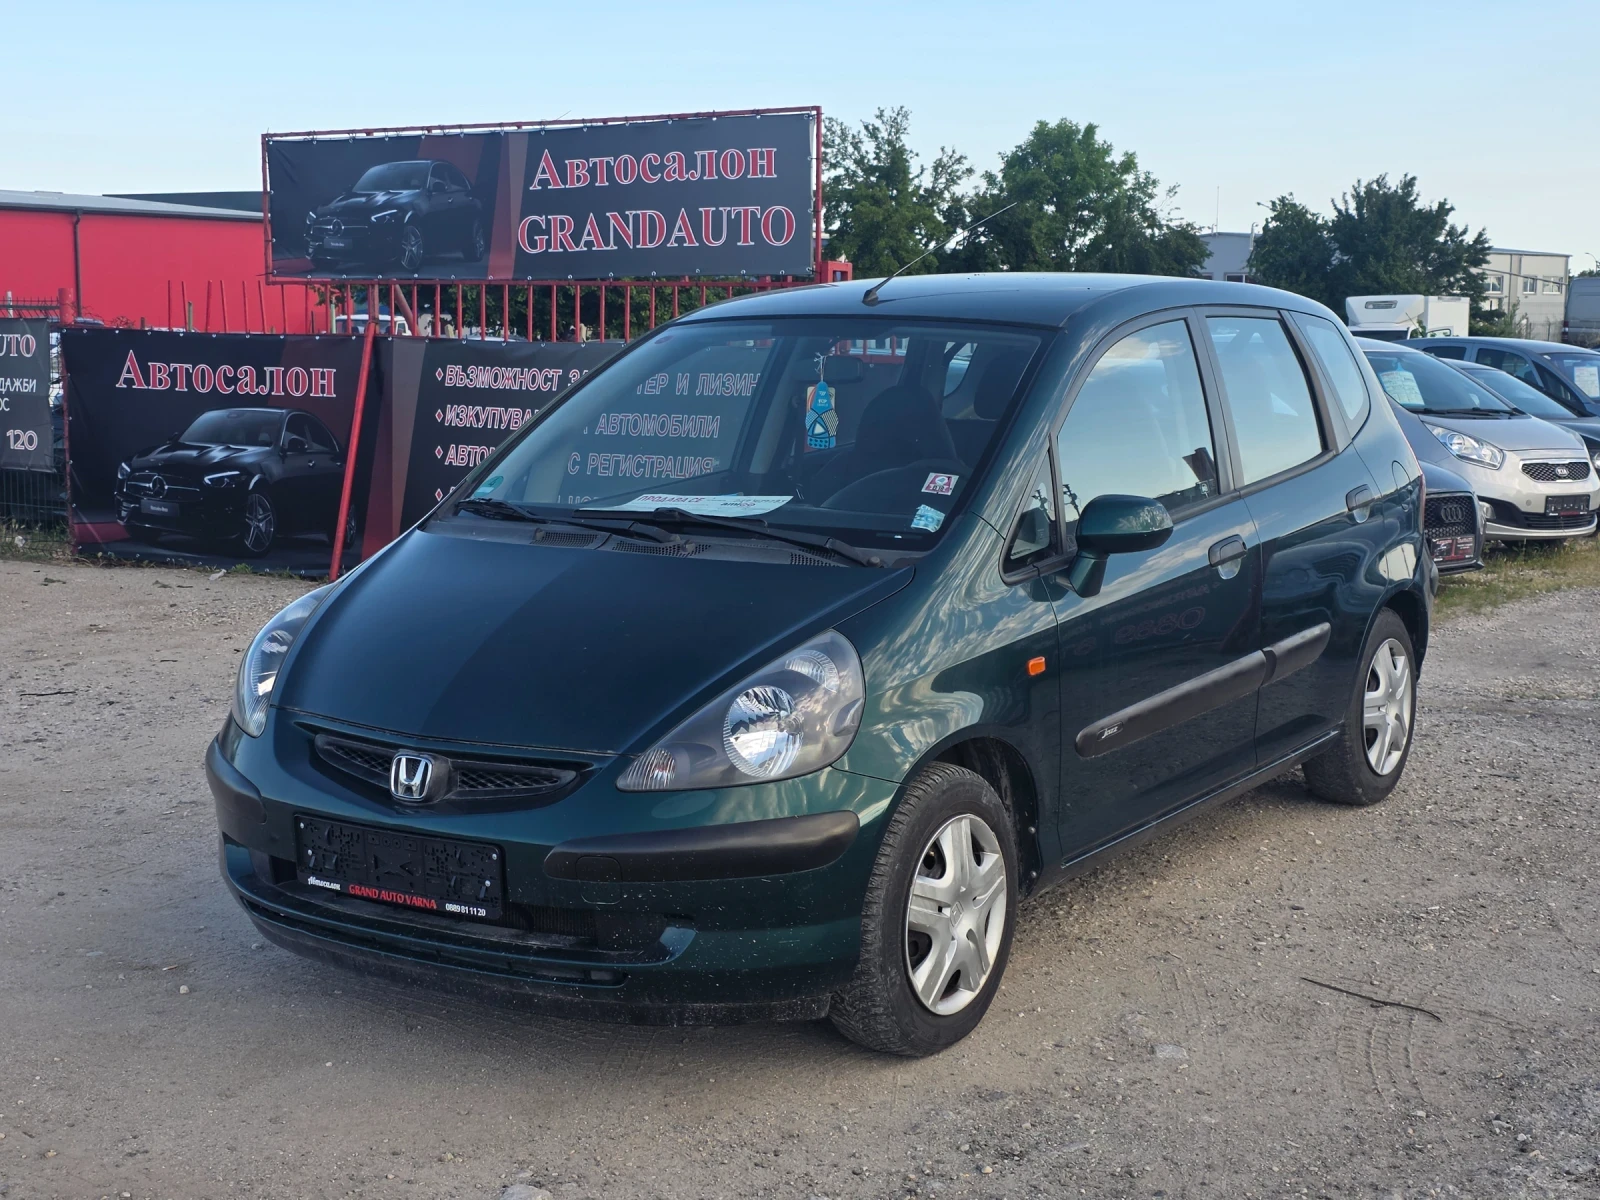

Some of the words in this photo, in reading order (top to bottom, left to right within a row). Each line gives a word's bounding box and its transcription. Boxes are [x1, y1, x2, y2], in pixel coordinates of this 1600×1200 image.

[529, 148, 777, 190] Автосалон
[518, 205, 796, 254] GRANDAUTO
[116, 349, 337, 398] Автосалон
[445, 364, 562, 392] ВЪЗМОЖНОСТ
[568, 369, 589, 387] З
[675, 373, 690, 396] И
[695, 373, 760, 397] ЛИЗИН
[445, 404, 540, 431] ИЗКУПУВА
[595, 413, 721, 439] АВТОМОБИЛИ
[444, 444, 496, 467] АВТО
[568, 452, 581, 475] С
[586, 453, 714, 479] РЕГИСТРАЦИЯ
[348, 884, 379, 899] GRAND
[380, 890, 405, 904] AUTO
[405, 894, 438, 910] VARNA
